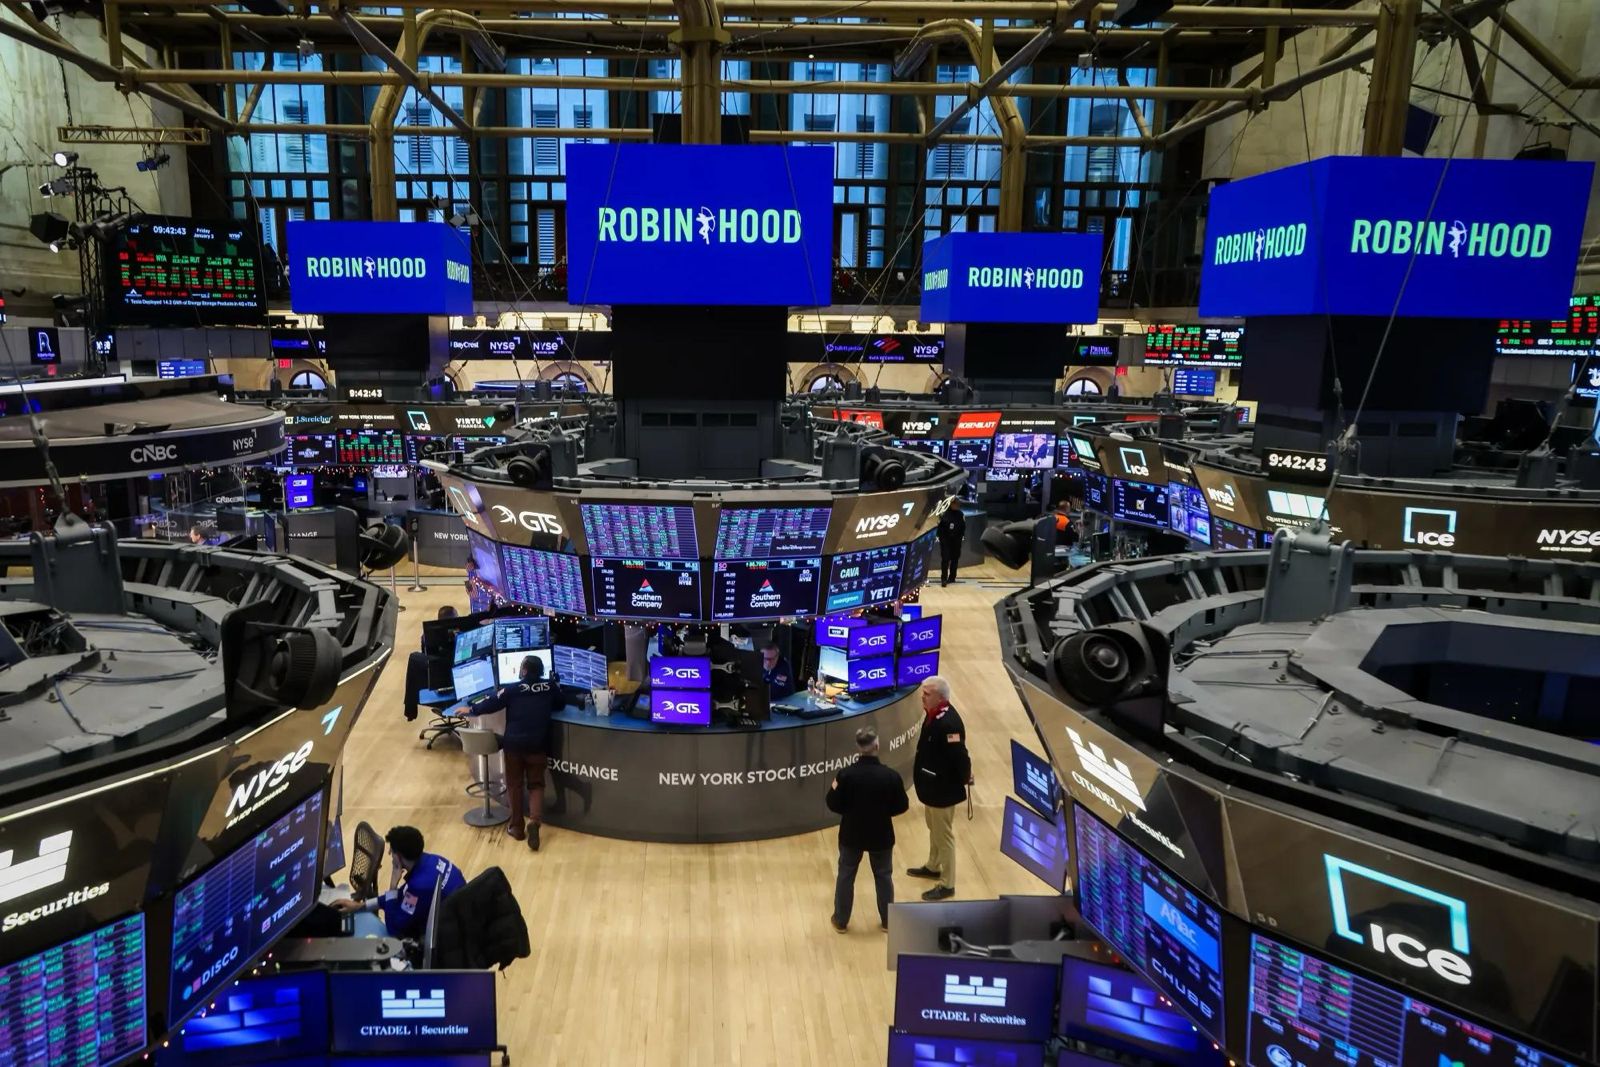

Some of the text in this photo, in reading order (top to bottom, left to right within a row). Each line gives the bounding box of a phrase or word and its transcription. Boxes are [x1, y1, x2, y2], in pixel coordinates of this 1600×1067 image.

[153, 226, 186, 236] 09:42:43
[598, 207, 801, 244] ROBIN HOOD
[1215, 223, 1307, 265] ROBIN HOOD
[1350, 219, 1552, 258] ROBIN HOOD
[307, 257, 426, 278] ROBIN HOOD
[968, 267, 1084, 289] ROBIN HOOD
[350, 390, 382, 398] 9:42:43
[130, 444, 178, 463] CNBC
[1269, 454, 1327, 472] 9:42:43
[518, 511, 563, 535] GTS
[840, 567, 860, 579] CAVA
[632, 593, 662, 601] Southern
[870, 587, 894, 600] YETI
[632, 600, 662, 609] Company
[868, 635, 887, 646] GTS
[918, 630, 934, 640] GTS
[676, 668, 700, 678] GTS
[868, 668, 887, 679] GTS
[914, 664, 930, 674] GTS
[531, 682, 550, 692] GTS
[676, 703, 700, 714] GTS
[890, 736, 906, 752] NEW
[547, 758, 619, 781] EXCHANGE
[659, 752, 861, 785] NEW YORK STOCK EXCHANG
[1071, 770, 1122, 814] CITADEL
[1128, 811, 1186, 859] Securities
[270, 836, 304, 870] NUCOR
[2, 882, 110, 934] Securities
[272, 891, 302, 923] TEREX
[1160, 903, 1196, 944] Aflac
[202, 946, 238, 986] DISCO
[1151, 958, 1213, 1019] CHUBB
[921, 1009, 1026, 1026] CITADEL Securities
[360, 1024, 468, 1036] CITADEL Securities
